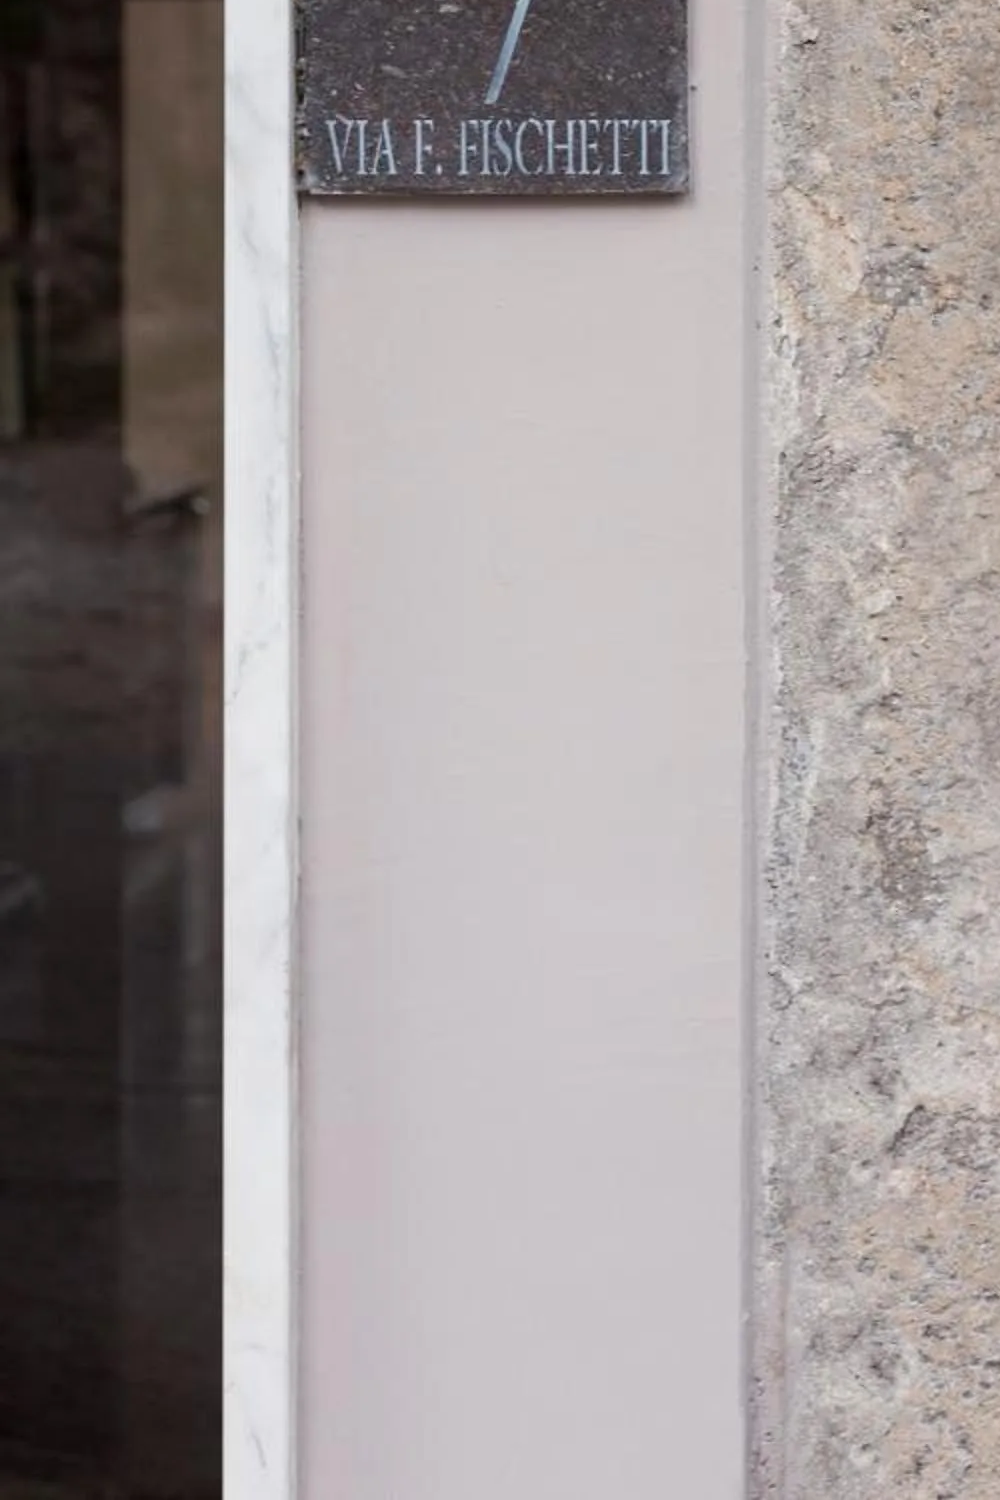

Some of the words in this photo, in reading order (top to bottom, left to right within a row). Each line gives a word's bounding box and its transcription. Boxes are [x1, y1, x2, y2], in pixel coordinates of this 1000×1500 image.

[325, 118, 398, 176] VIA
[412, 118, 444, 176] F.
[457, 118, 673, 177] FISCHETTI
